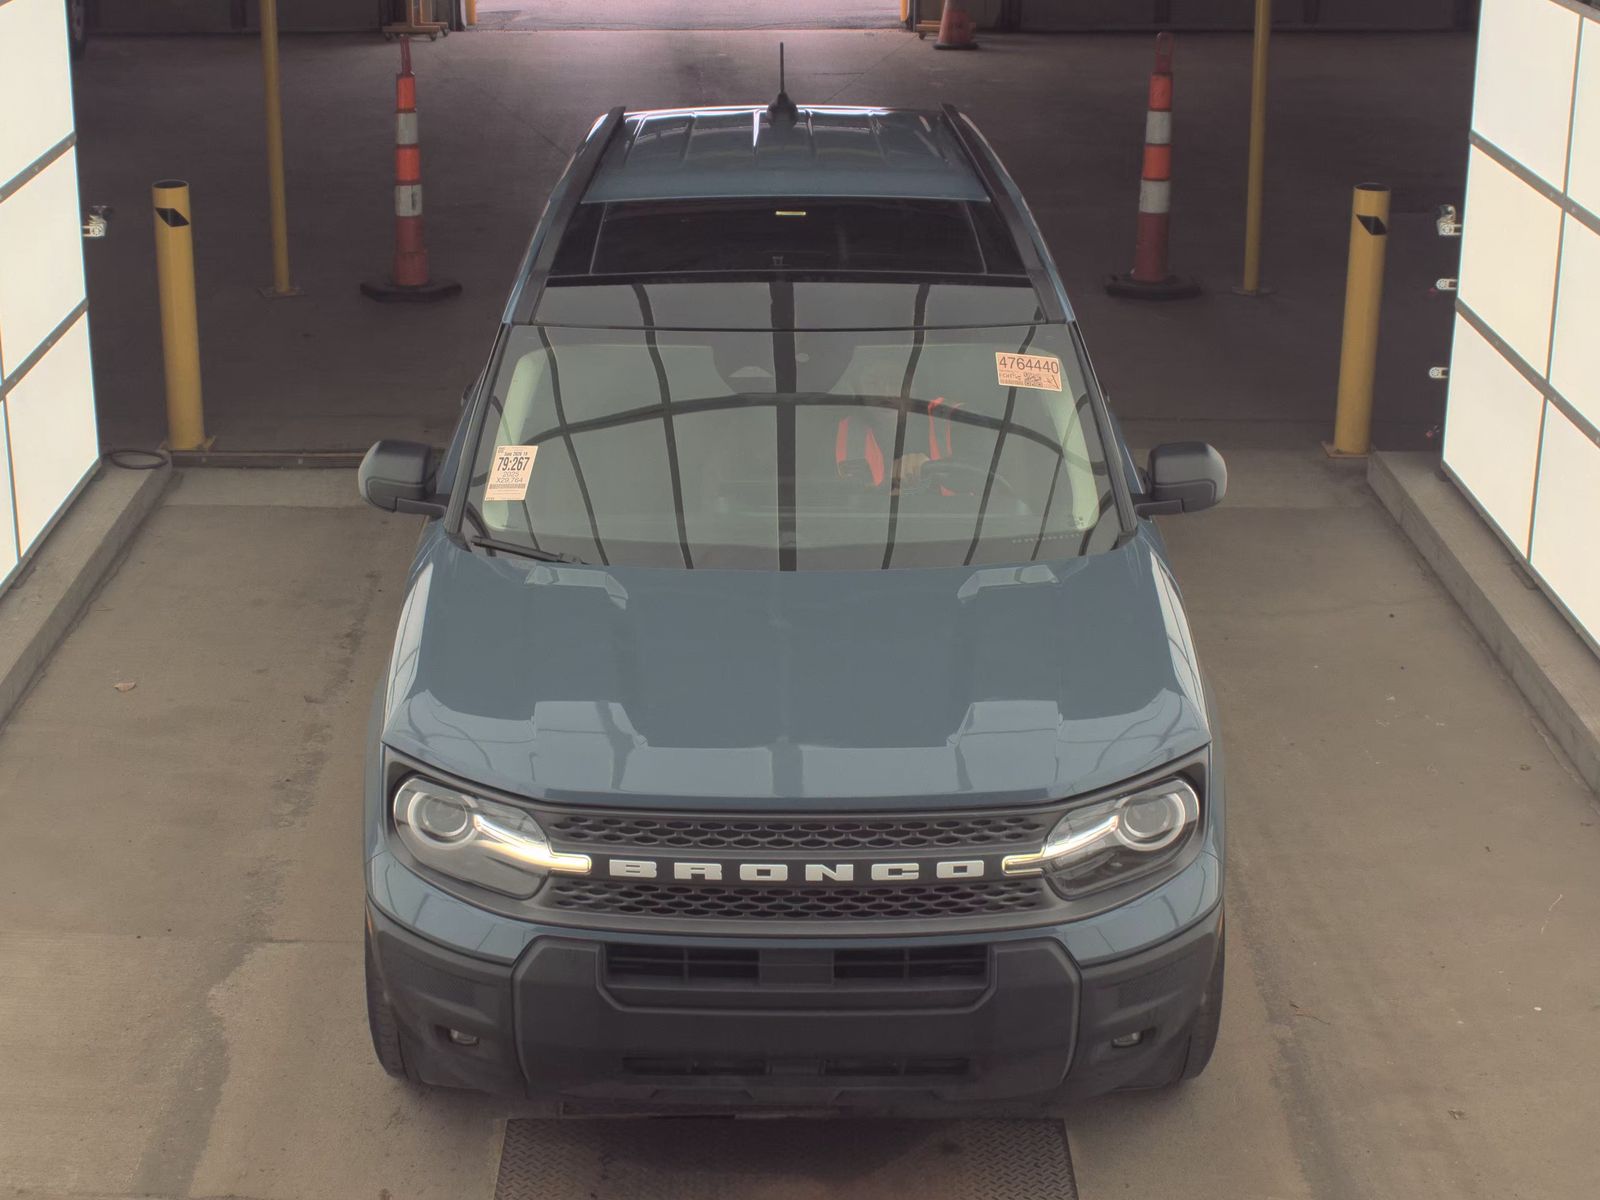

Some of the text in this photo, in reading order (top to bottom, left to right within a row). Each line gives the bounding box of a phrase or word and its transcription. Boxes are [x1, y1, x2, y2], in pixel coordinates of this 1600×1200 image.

[1000, 356, 1059, 374] 4764440
[497, 456, 531, 471] 79:267
[609, 859, 985, 881] BRONCO
